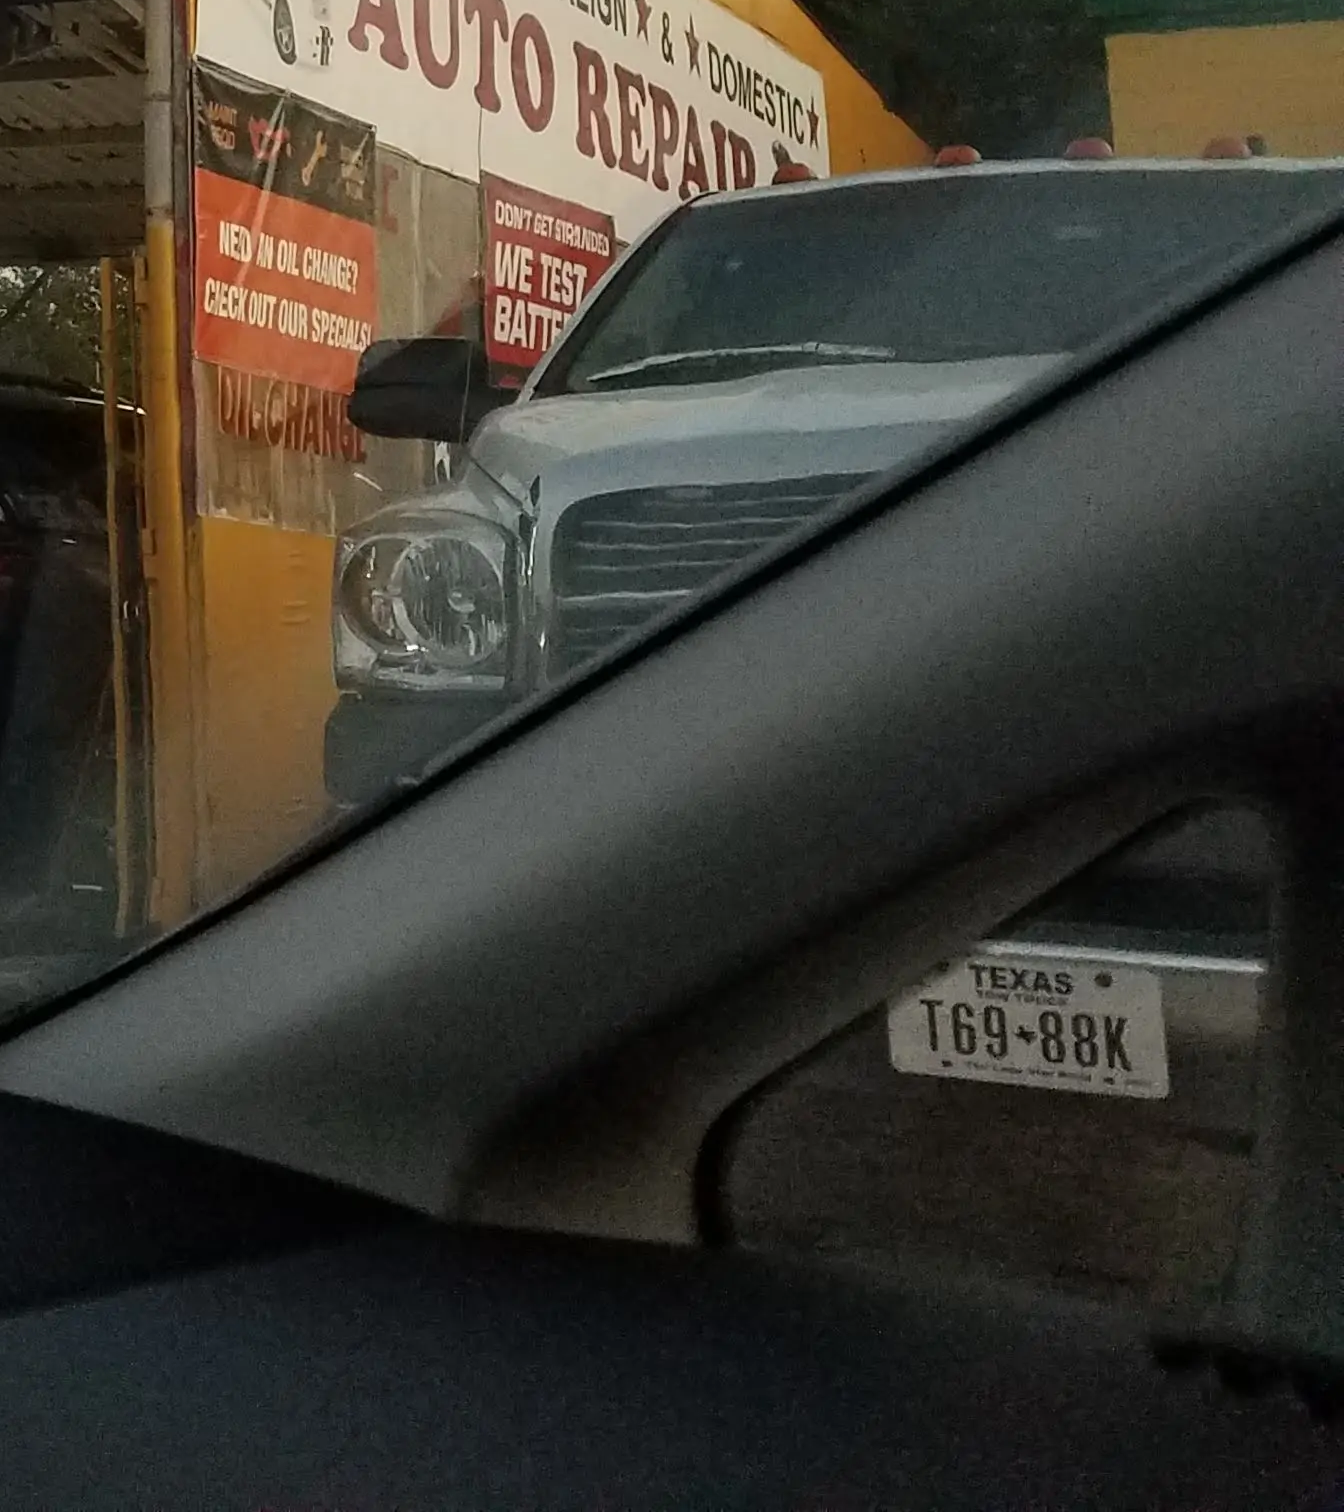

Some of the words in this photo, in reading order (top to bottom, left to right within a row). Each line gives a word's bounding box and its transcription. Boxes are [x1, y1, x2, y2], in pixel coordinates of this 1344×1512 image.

[661, 10, 675, 64] &
[707, 39, 806, 145] DOMESTIC
[574, 40, 756, 200] REPAIR
[495, 199, 533, 232] DON'T
[534, 212, 554, 238] GET
[555, 218, 610, 257] STRANDED
[256, 232, 274, 270] AN
[277, 239, 299, 277] OIL
[302, 246, 358, 295] CHANGE?
[494, 240, 533, 294] WE
[540, 251, 587, 311] TEST
[204, 277, 249, 322] CHECK
[248, 290, 277, 330] OUT
[278, 298, 308, 341] OUR
[494, 294, 572, 352] BATTE
[967, 963, 1074, 995] TEXAS
